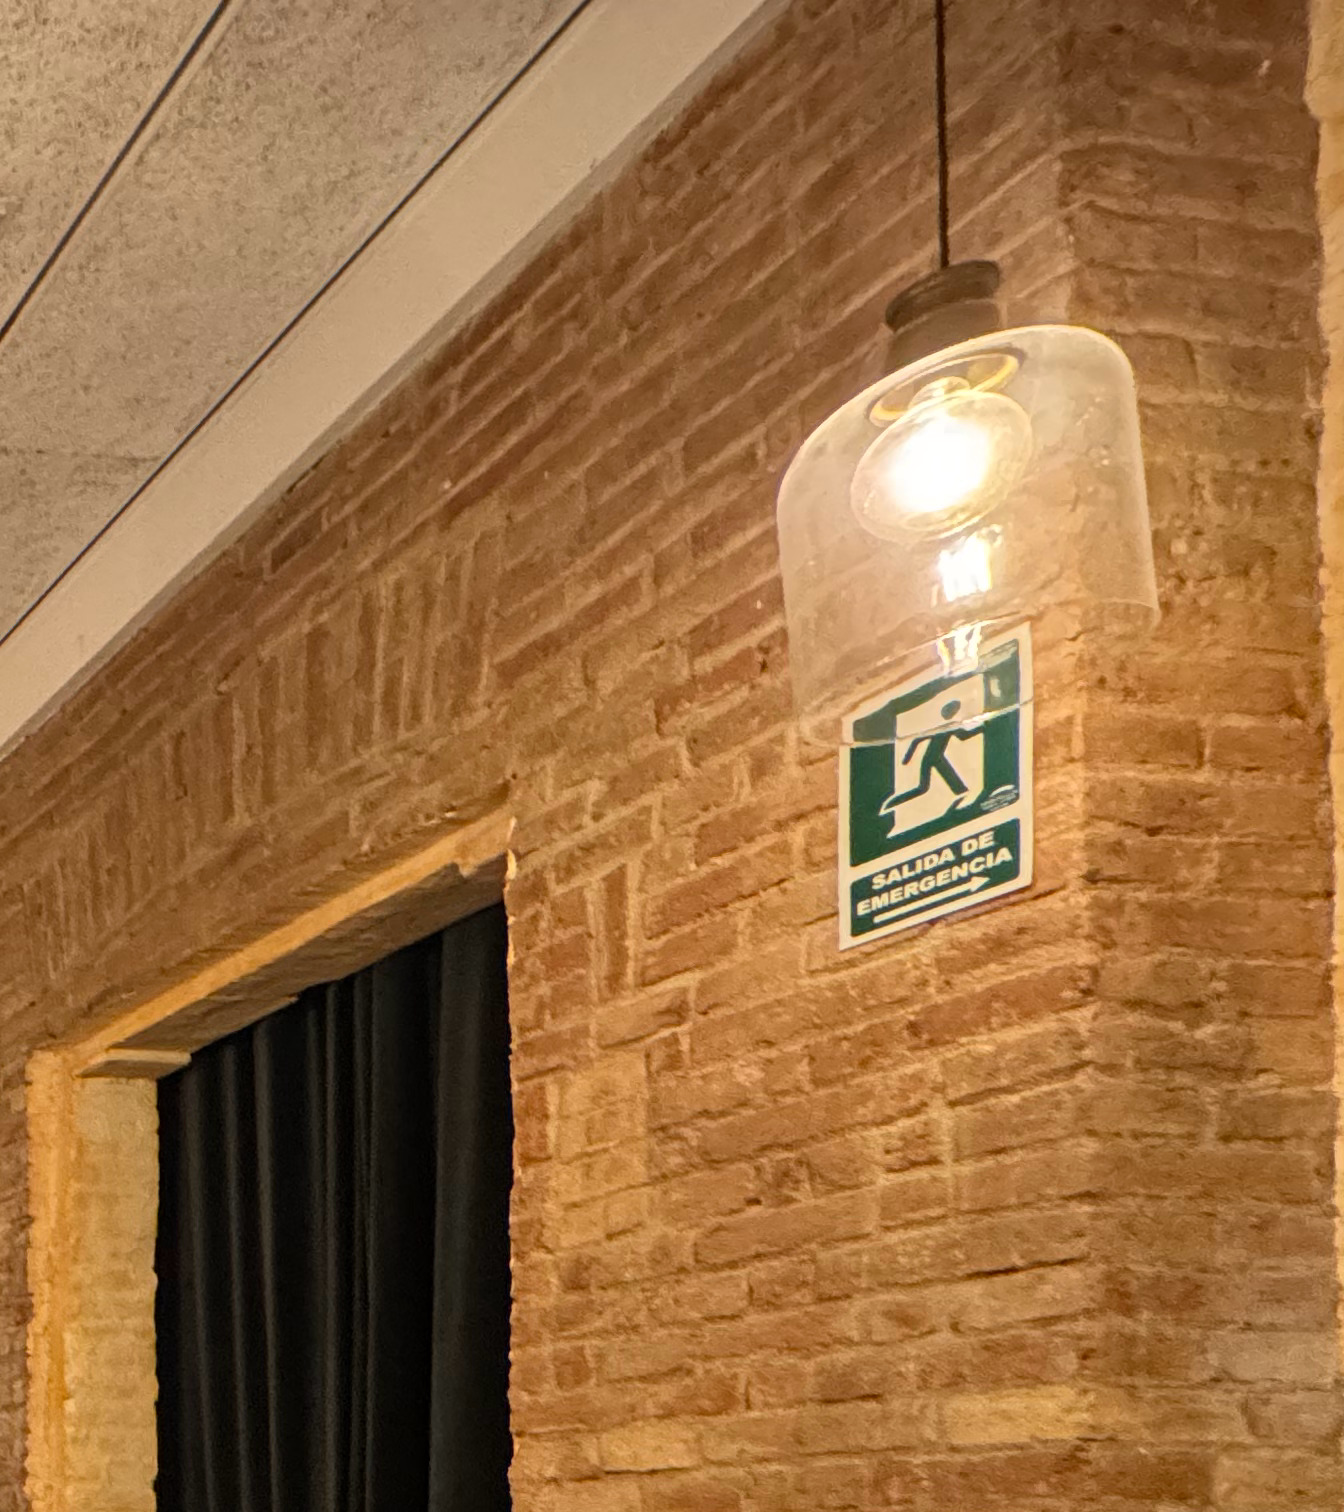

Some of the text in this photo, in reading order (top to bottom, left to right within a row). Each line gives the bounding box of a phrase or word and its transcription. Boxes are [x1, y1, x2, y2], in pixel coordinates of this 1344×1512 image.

[856, 847, 1013, 916] EMERGENCIA
[871, 830, 995, 890] SALIDA DE
